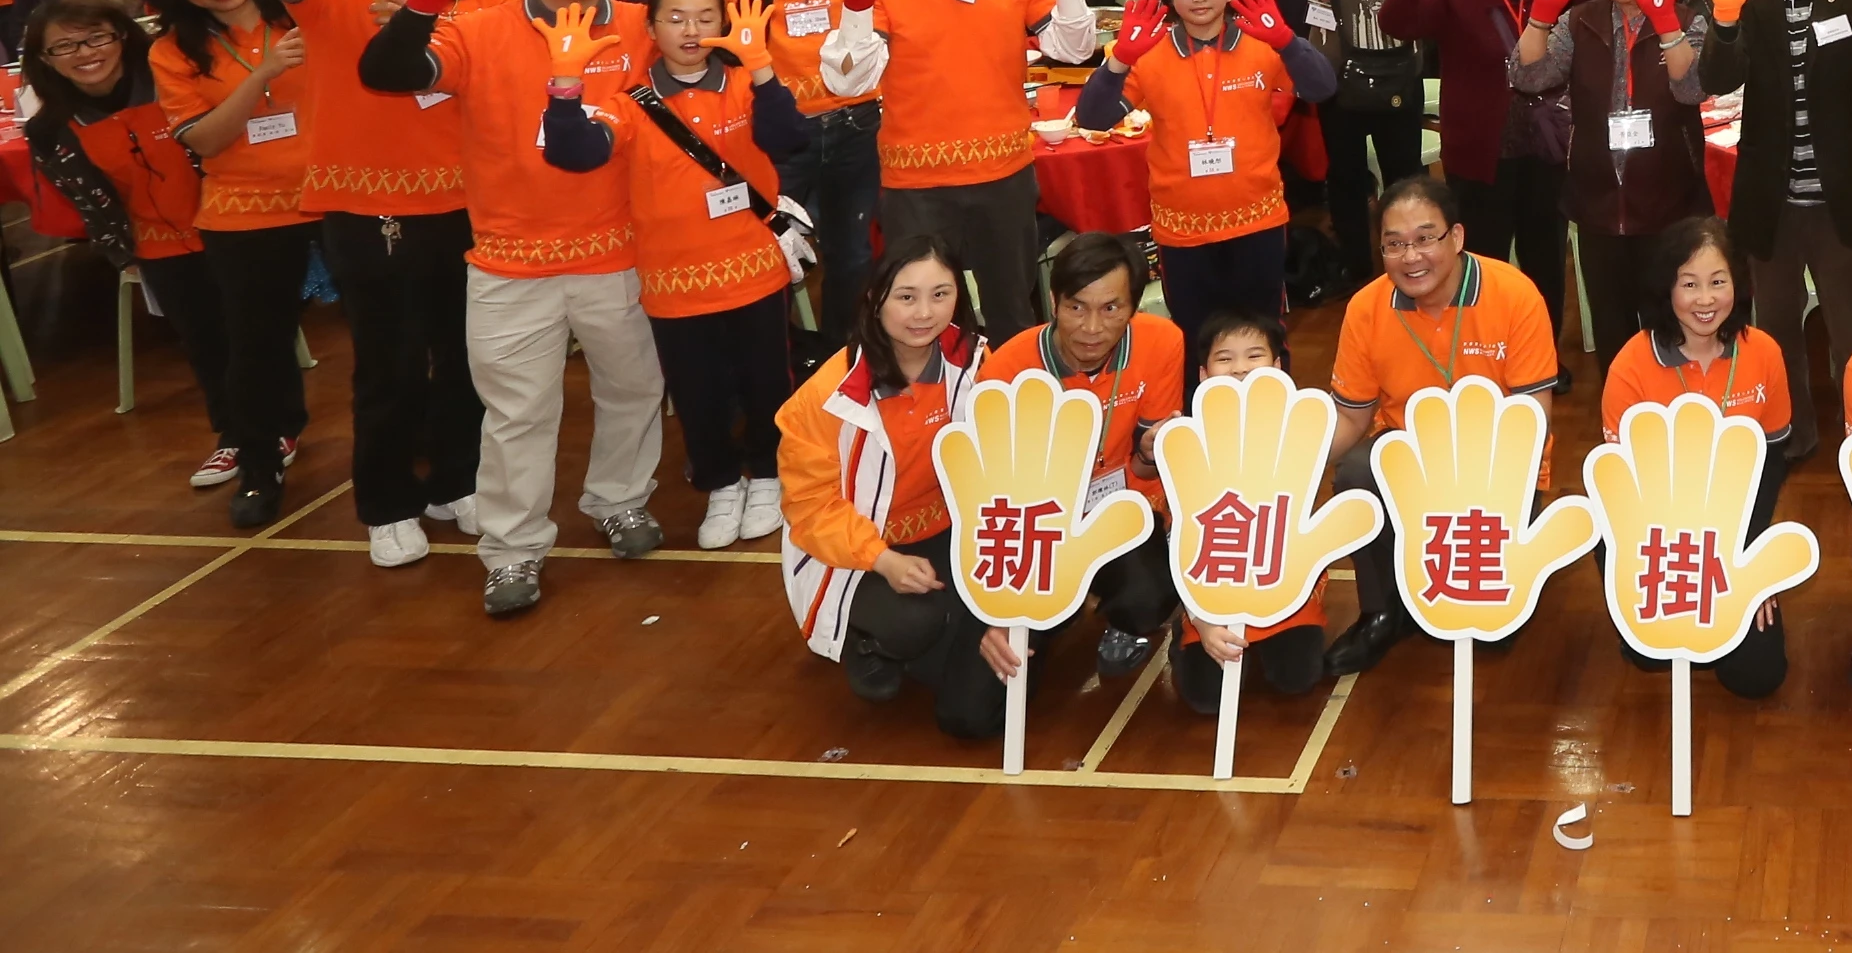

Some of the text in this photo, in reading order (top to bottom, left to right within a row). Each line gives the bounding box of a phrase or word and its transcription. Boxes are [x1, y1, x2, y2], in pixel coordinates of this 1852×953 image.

[1261, 14, 1274, 27] 0
[741, 28, 751, 44] 0
[1131, 27, 1141, 40] 1
[563, 35, 572, 52] 1
[584, 66, 601, 74] NWS
[1222, 83, 1237, 91] NWS
[975, 498, 1062, 591] 新
[1188, 492, 1286, 586] 創
[1422, 509, 1511, 603] 建
[1639, 528, 1728, 625] 掛
